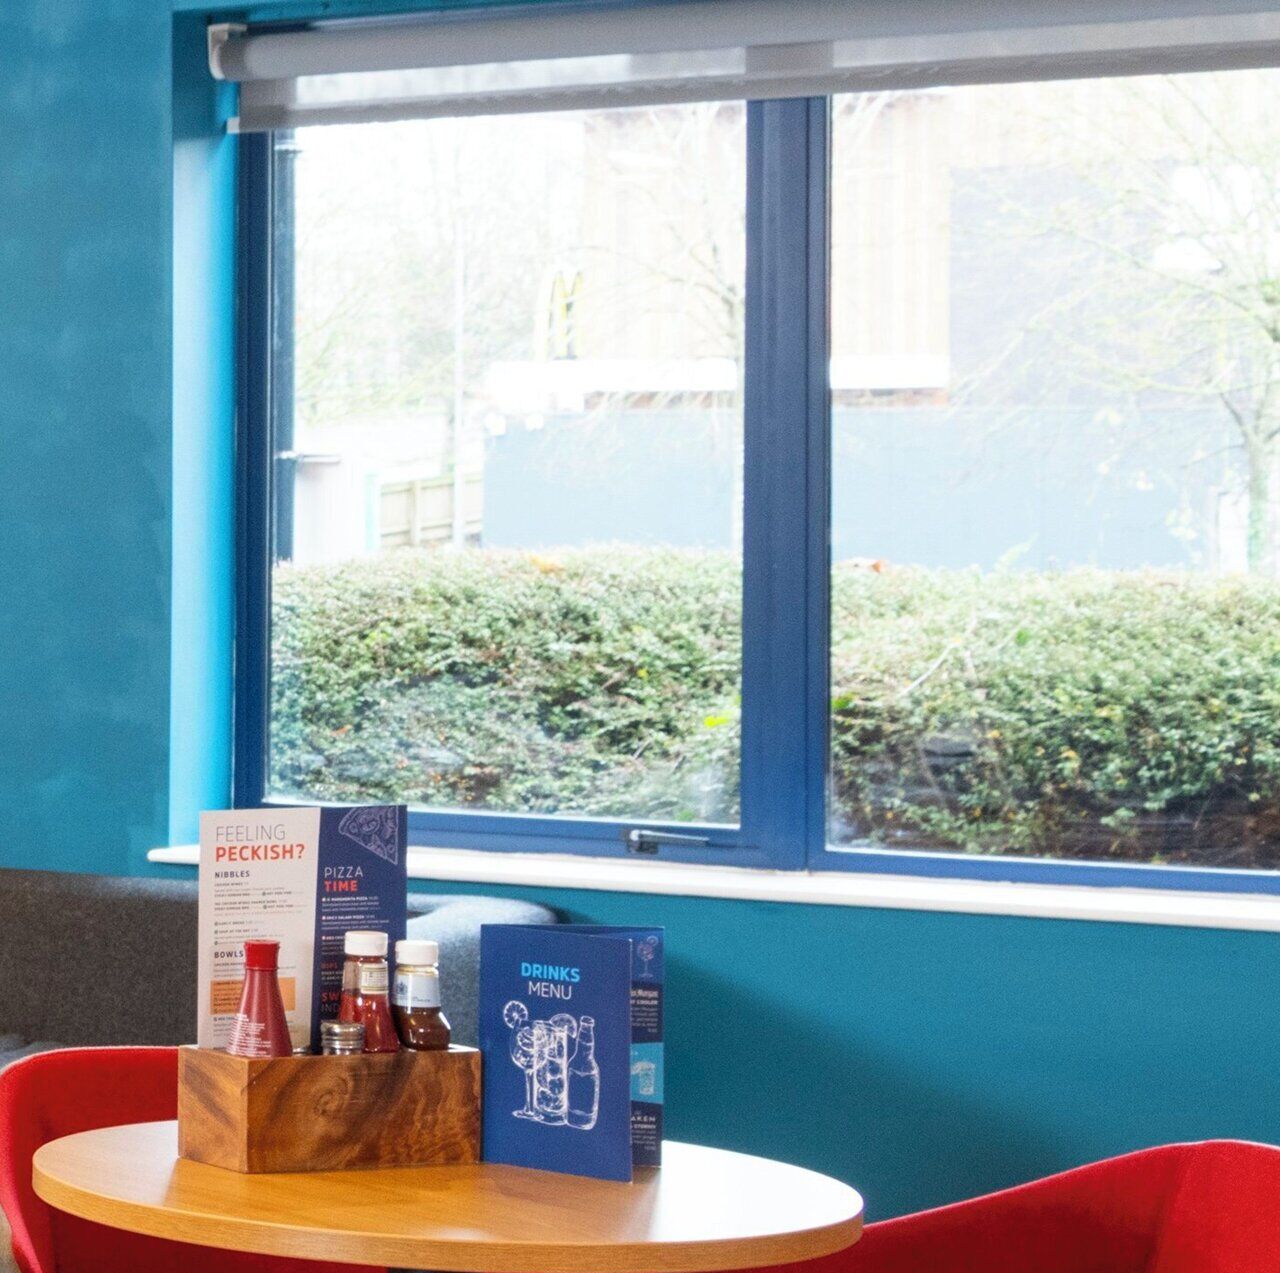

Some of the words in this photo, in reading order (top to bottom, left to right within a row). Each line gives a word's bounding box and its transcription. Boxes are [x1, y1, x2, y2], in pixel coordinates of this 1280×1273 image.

[215, 824, 286, 842] FEELING
[215, 844, 305, 863] PECKISH?
[214, 870, 250, 879] NIBBLES
[324, 866, 364, 879] PIZZA
[324, 880, 358, 892] TIME
[214, 950, 244, 959] BOWLS
[521, 962, 580, 982] DRINKS
[528, 981, 572, 1000] MENU
